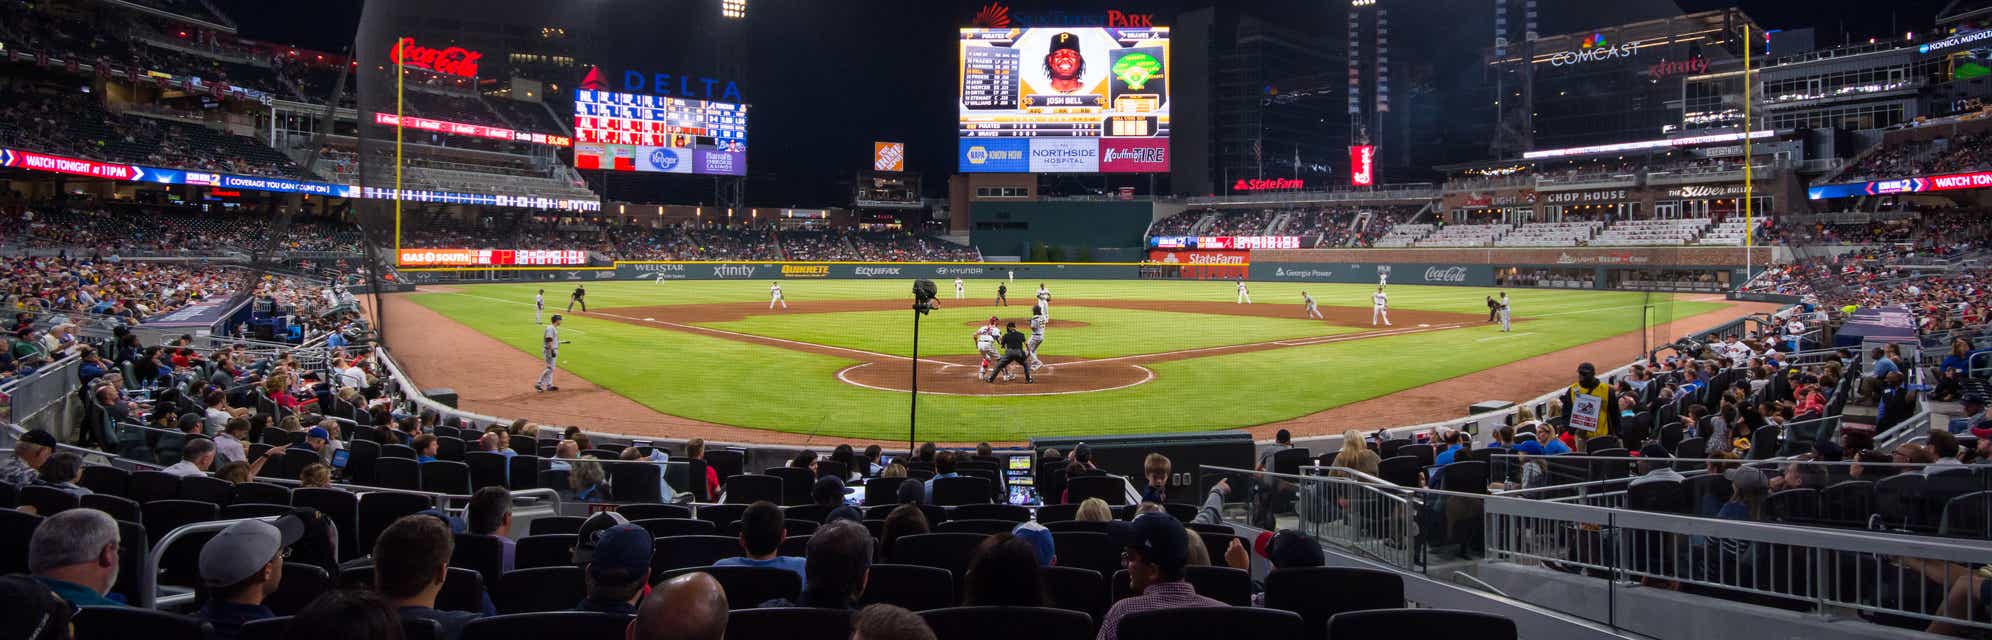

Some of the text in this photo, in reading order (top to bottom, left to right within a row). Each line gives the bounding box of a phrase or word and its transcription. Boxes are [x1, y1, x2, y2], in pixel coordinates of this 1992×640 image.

[1108, 10, 1152, 26] PARK
[1930, 38, 1960, 50] KONICA
[1551, 41, 1641, 67] COMCAST
[1650, 56, 1710, 79] xfinity
[624, 69, 741, 101] DELTA
[970, 151, 985, 160] NAPA
[1032, 149, 1096, 157] NORTHSIDE
[1134, 148, 1164, 162] TIRE
[26, 155, 54, 168] WATCH
[56, 160, 90, 173] TONIGHT
[102, 166, 126, 177] 11PM
[651, 152, 678, 169] Kroger
[231, 178, 265, 188] COVERAGE
[266, 181, 279, 189] YOU
[280, 182, 294, 190] CAN
[1936, 174, 1970, 188] WATCH
[1548, 190, 1626, 202] CHOP HOUSE
[1682, 186, 1724, 197] Silver
[1492, 196, 1517, 205] LIGHT
[402, 253, 424, 262] GAS
[436, 253, 469, 262] SOUTH
[635, 264, 684, 272] WELLSTAR
[714, 264, 755, 278] xfinity
[781, 265, 830, 274] QUIKRETE
[855, 267, 900, 276] EQUIFAX
[1286, 270, 1311, 278] Georgia
